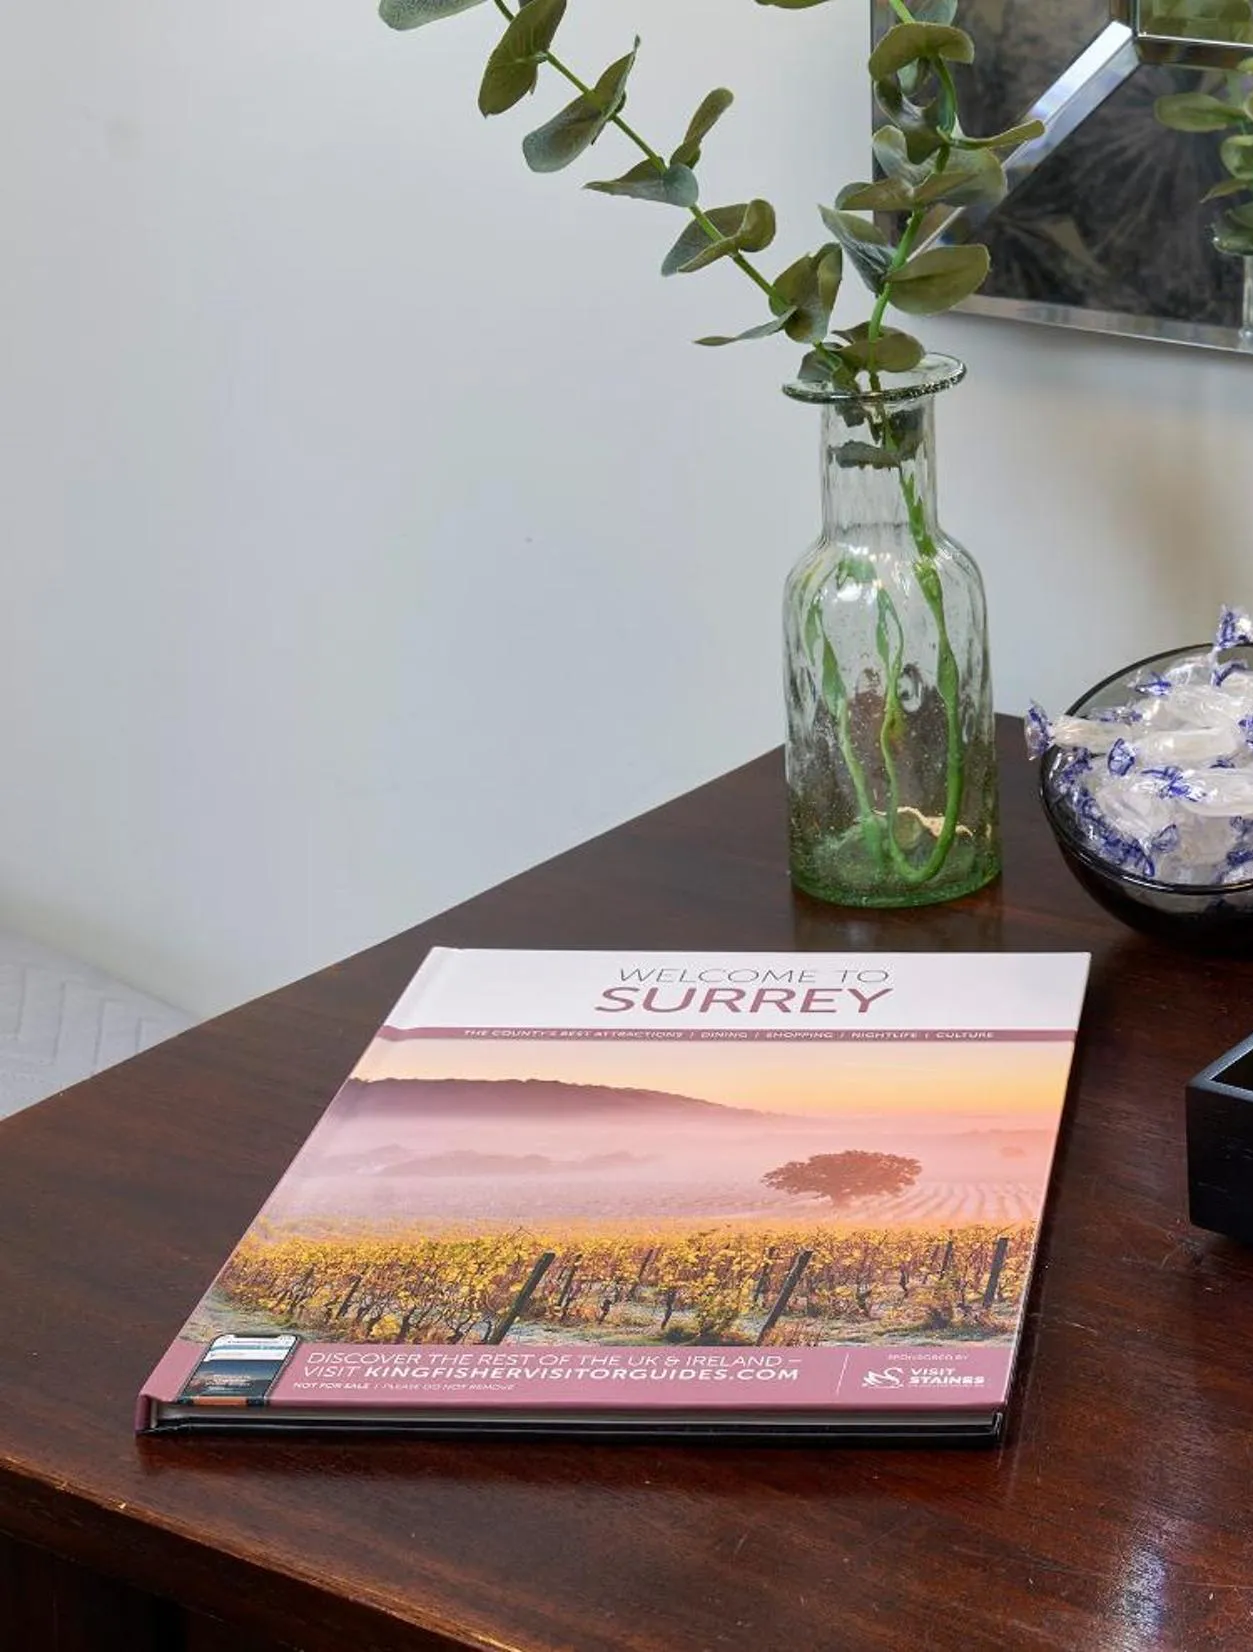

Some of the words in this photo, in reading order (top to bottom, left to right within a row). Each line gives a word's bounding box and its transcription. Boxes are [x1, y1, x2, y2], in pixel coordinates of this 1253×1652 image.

[620, 968, 817, 983] WELCOME
[836, 969, 890, 983] TO
[594, 987, 893, 1013] SURREY
[593, 1030, 683, 1038] ATTRACTIONS
[701, 1031, 748, 1039] DINING
[306, 1352, 421, 1364] DISCOVER
[428, 1353, 473, 1365] THE
[477, 1353, 536, 1365] REST
[538, 1354, 572, 1365] OF
[580, 1354, 622, 1366] THE
[628, 1355, 661, 1366] UK
[664, 1355, 681, 1367] &
[686, 1355, 783, 1366] IRELAND
[303, 1366, 361, 1377] VISIT
[364, 1366, 799, 1380] KINGFISHERVISITORGUIDES.COM
[909, 1376, 985, 1384] STAINES
